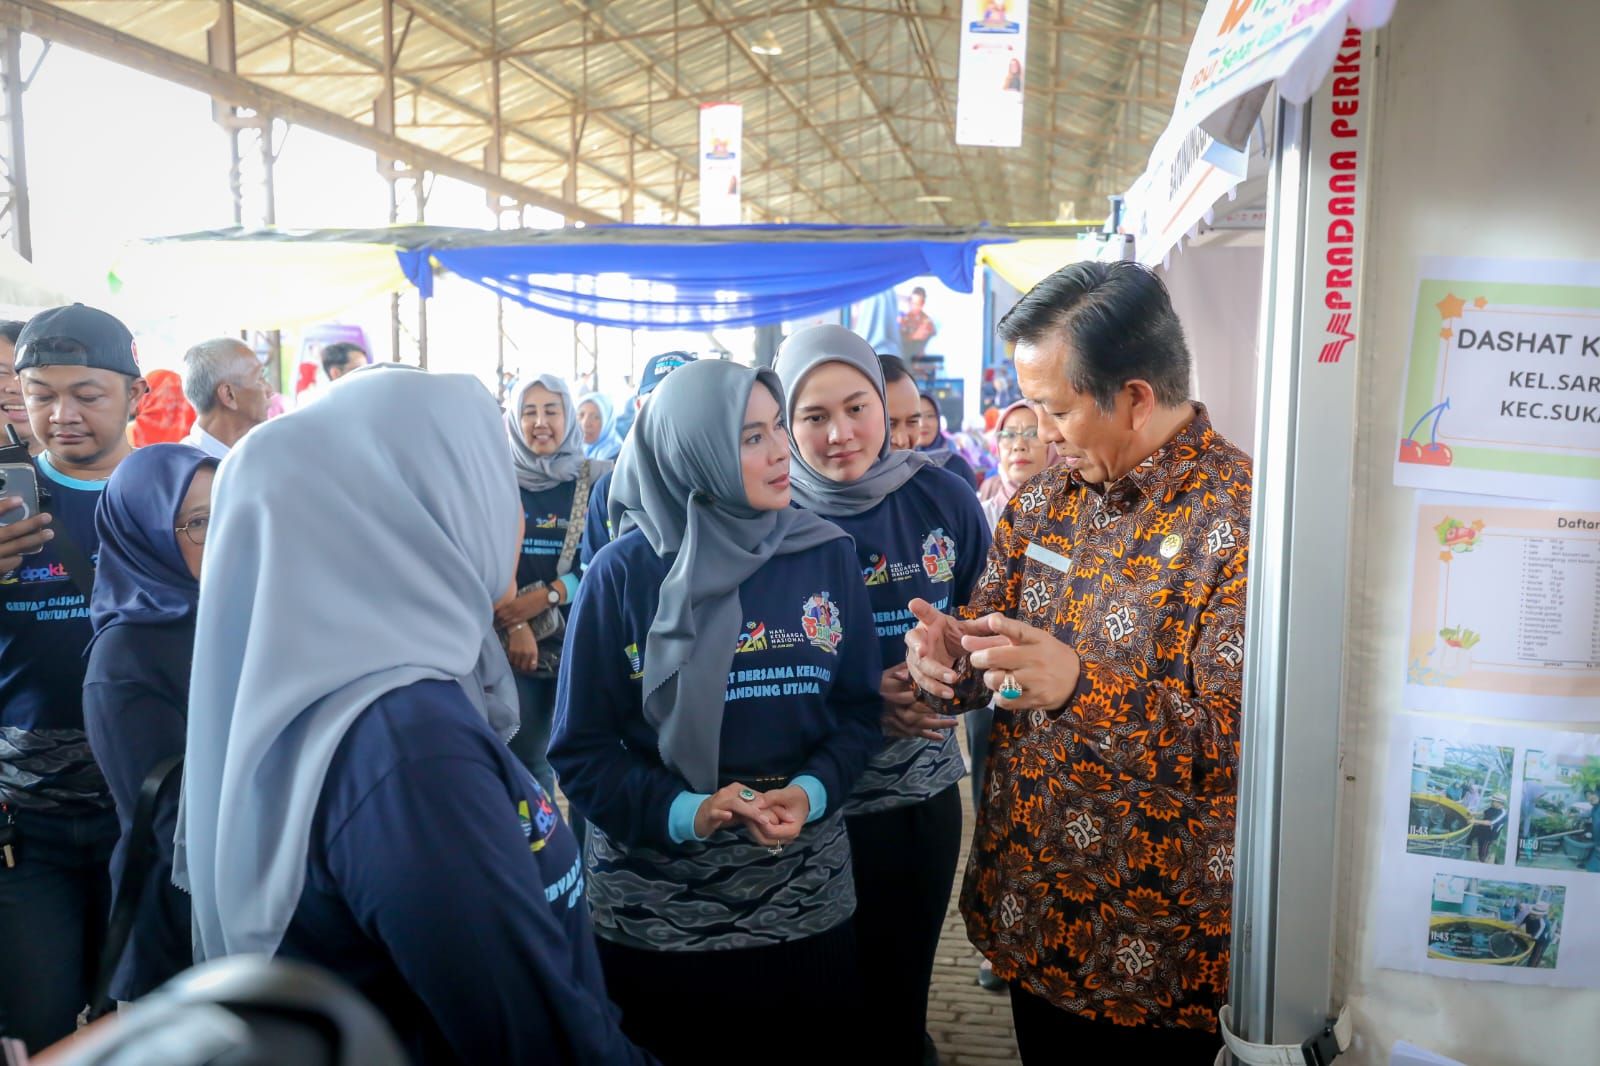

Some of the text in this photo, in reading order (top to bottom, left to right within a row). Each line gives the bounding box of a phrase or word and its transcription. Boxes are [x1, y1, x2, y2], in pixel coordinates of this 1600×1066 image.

[1324, 26, 1361, 310] PRADANA PERKA
[1458, 328, 1573, 355] DASHAT
[1509, 370, 1600, 393] KEL.SAR
[1557, 517, 1600, 529] Daftar
[738, 666, 795, 682] BERSAMA
[783, 682, 820, 695] UTAMA
